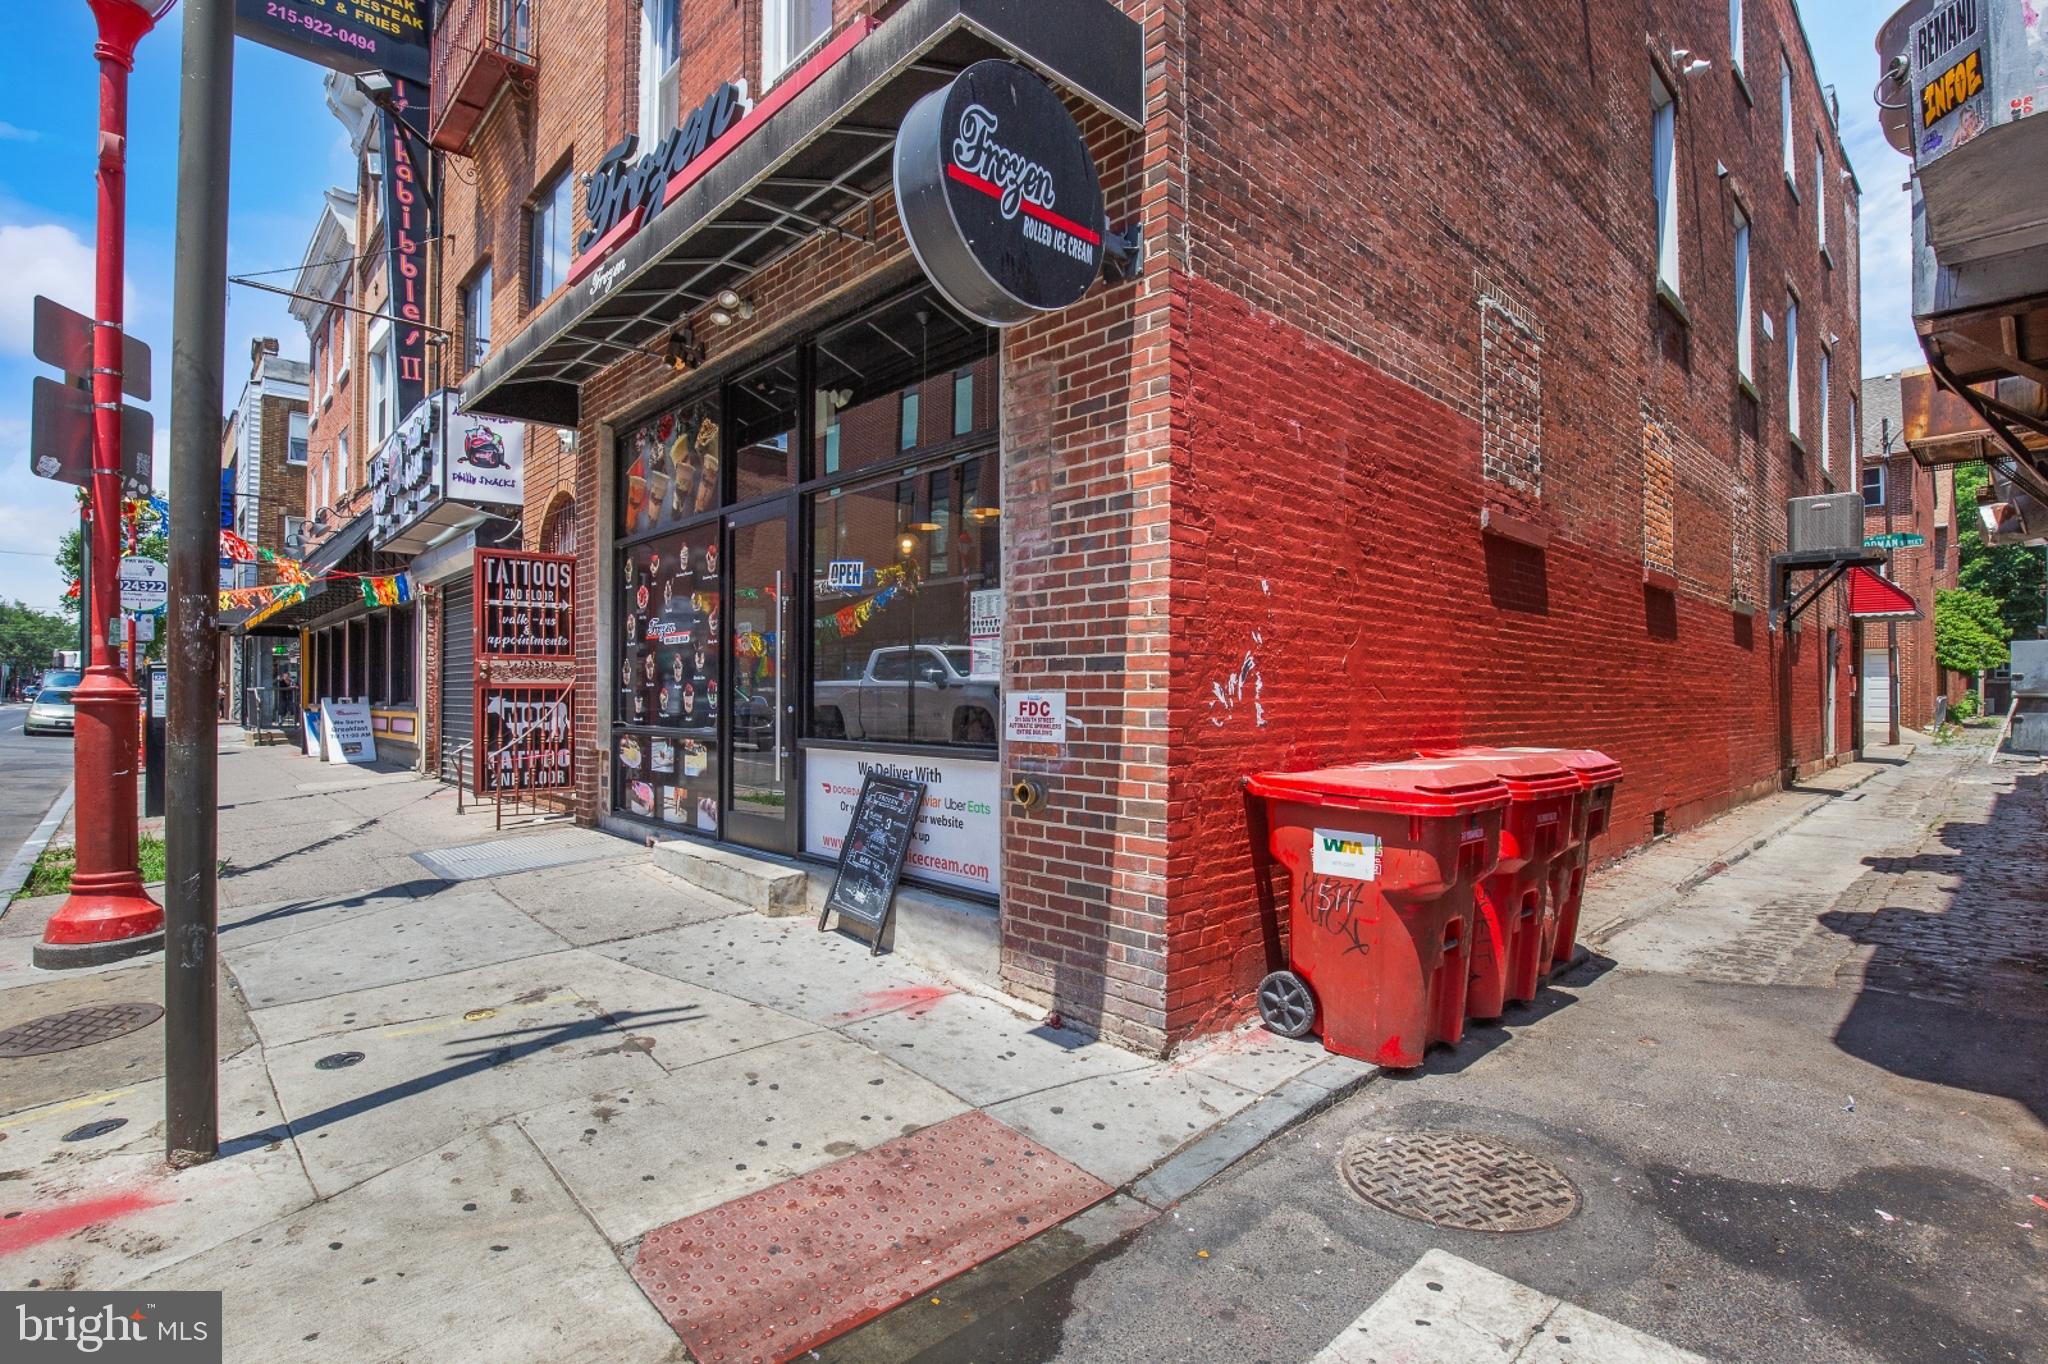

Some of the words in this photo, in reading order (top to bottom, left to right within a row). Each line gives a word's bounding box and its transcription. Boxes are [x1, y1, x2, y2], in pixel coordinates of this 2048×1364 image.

[267, 2, 376, 53] 215-922-0494
[335, 2, 348, 15] &
[355, 9, 401, 34] FRIES
[1918, 0, 1978, 71] REMAND
[1924, 52, 1983, 128] INFOE
[578, 80, 747, 256] Frozen
[953, 104, 1056, 220] Frozen
[1023, 215, 1052, 249] ROLLED
[1053, 229, 1067, 253] ICE
[1068, 235, 1094, 267] CREAM
[590, 257, 628, 295] Frozen
[1864, 539, 1898, 549] ODMAN
[484, 557, 571, 588] TATTOOS
[831, 562, 863, 585] OPEN
[504, 588, 523, 600] 2ND
[487, 632, 570, 648] appointments
[1019, 700, 1051, 717] FDC
[524, 769, 566, 785] FOOR
[858, 761, 874, 777] We
[875, 763, 914, 781] Deliver
[915, 766, 942, 783] With
[920, 796, 942, 808] viar
[944, 798, 967, 812] Uber
[967, 800, 992, 815] Eats
[930, 815, 964, 829] website
[918, 832, 931, 845] up
[1323, 838, 1364, 855] WM
